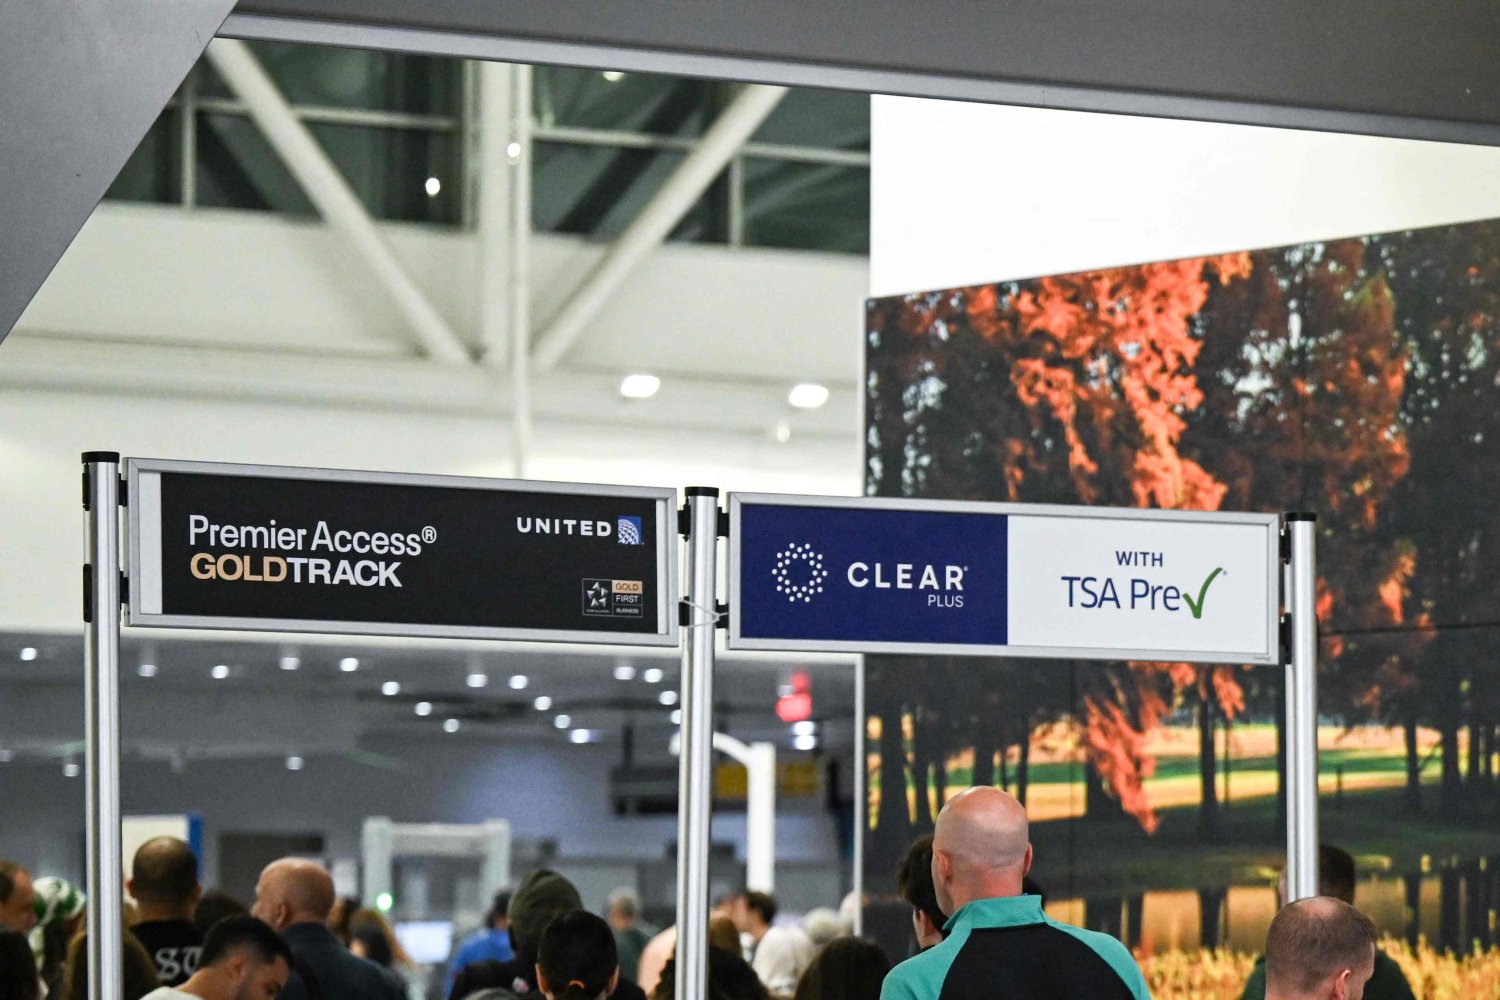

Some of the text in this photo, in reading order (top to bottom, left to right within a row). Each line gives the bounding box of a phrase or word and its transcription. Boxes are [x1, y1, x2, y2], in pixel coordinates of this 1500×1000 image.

[189, 514, 308, 551] Premier
[516, 516, 612, 537] UNITED
[1115, 550, 1163, 568] WITH
[847, 561, 965, 591] CLEAR
[615, 582, 639, 591] GOLD
[1061, 575, 1181, 612] TSA Pre
[615, 594, 640, 603] FIRST
[927, 594, 964, 608] PLUS
